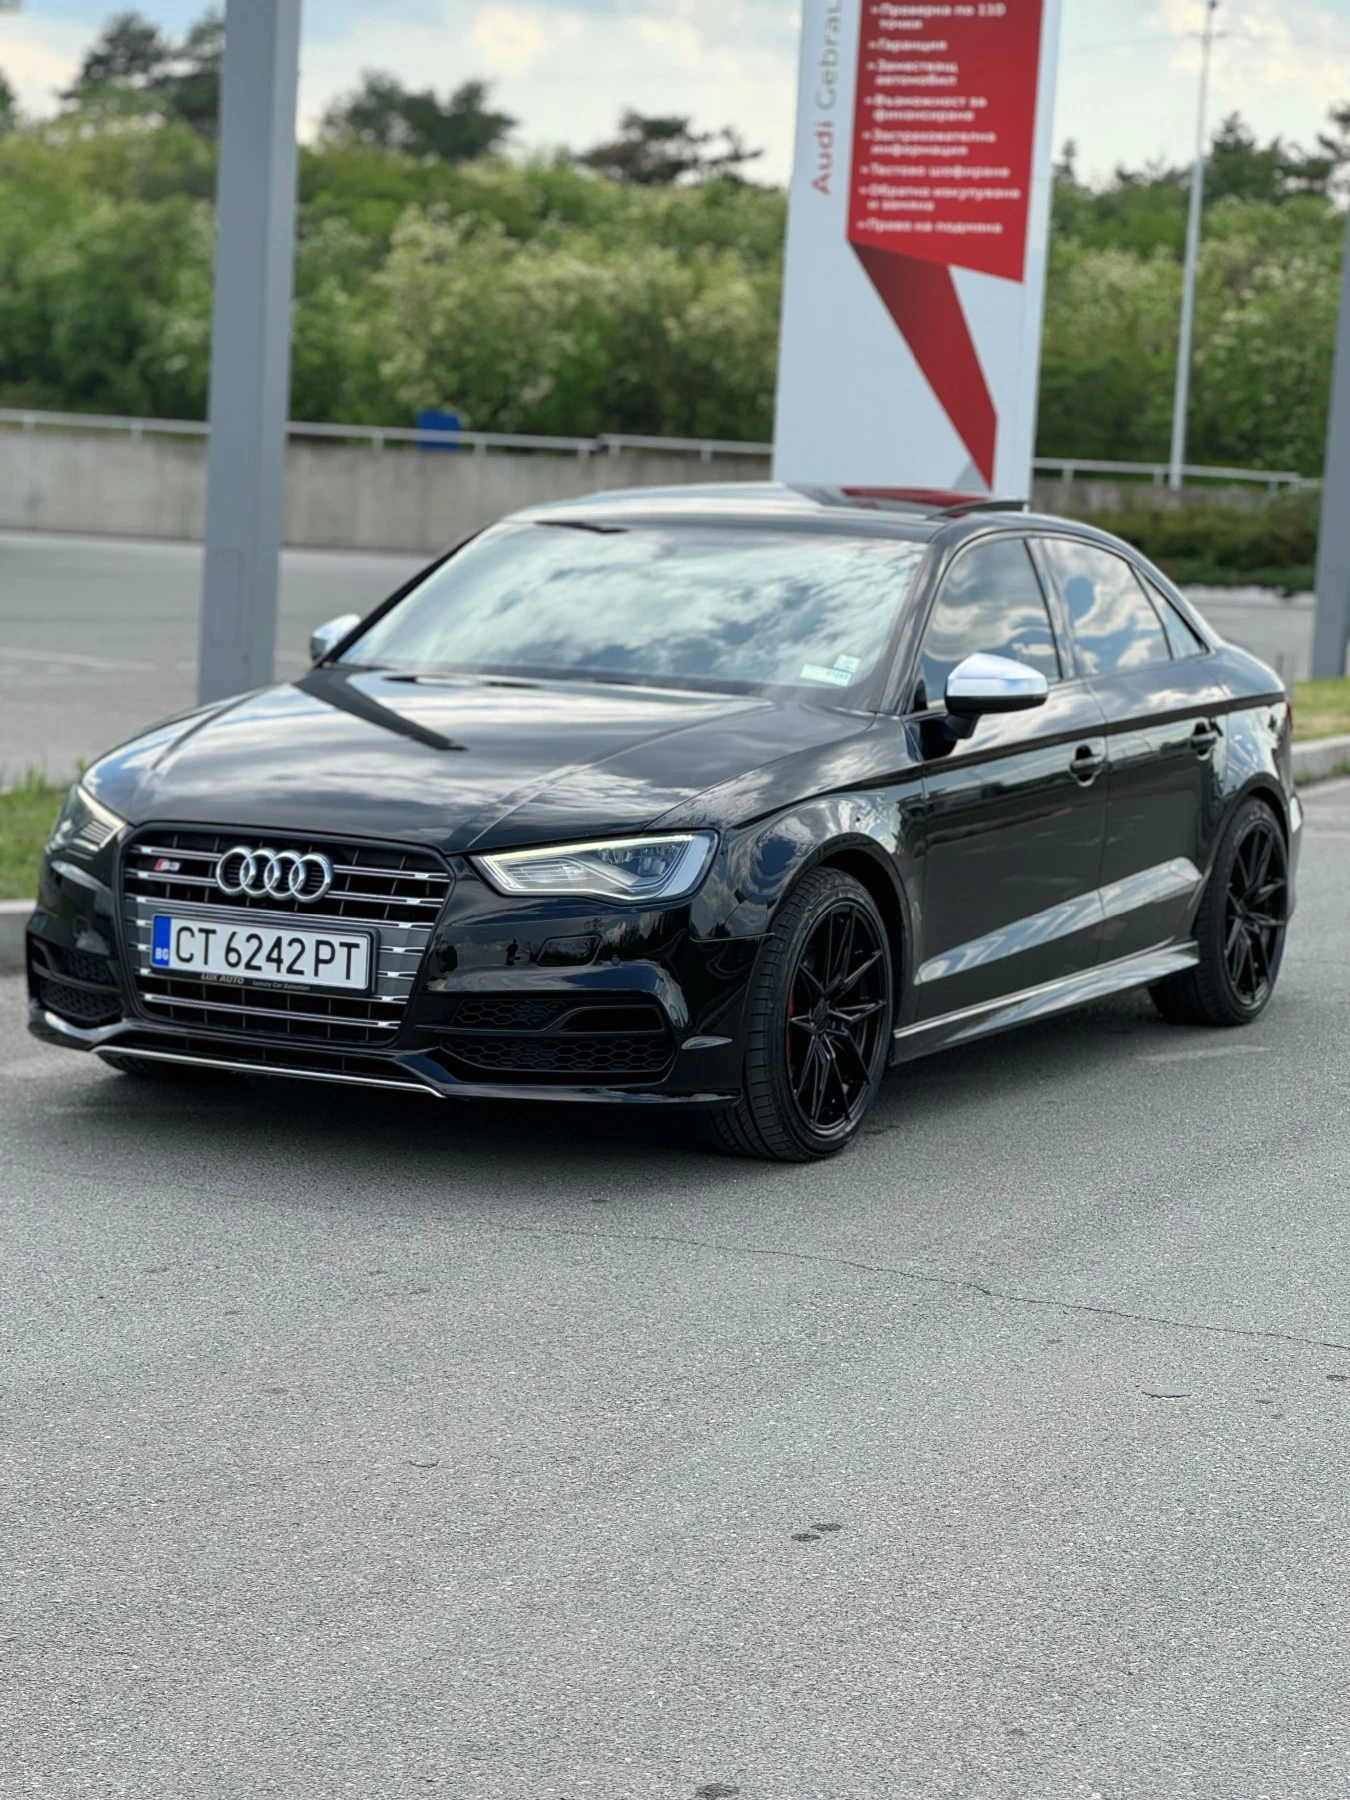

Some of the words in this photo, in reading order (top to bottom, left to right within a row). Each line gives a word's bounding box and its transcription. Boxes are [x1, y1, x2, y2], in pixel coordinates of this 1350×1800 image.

[811, 120, 834, 196] Audi
[155, 947, 169, 960] BG
[175, 926, 217, 966] CT
[224, 931, 305, 976] 6242
[314, 939, 360, 980] PT
[201, 973, 218, 982] LUX
[219, 974, 244, 984] AUTO
[252, 980, 272, 989] Luxury
[283, 983, 311, 991] Selection
